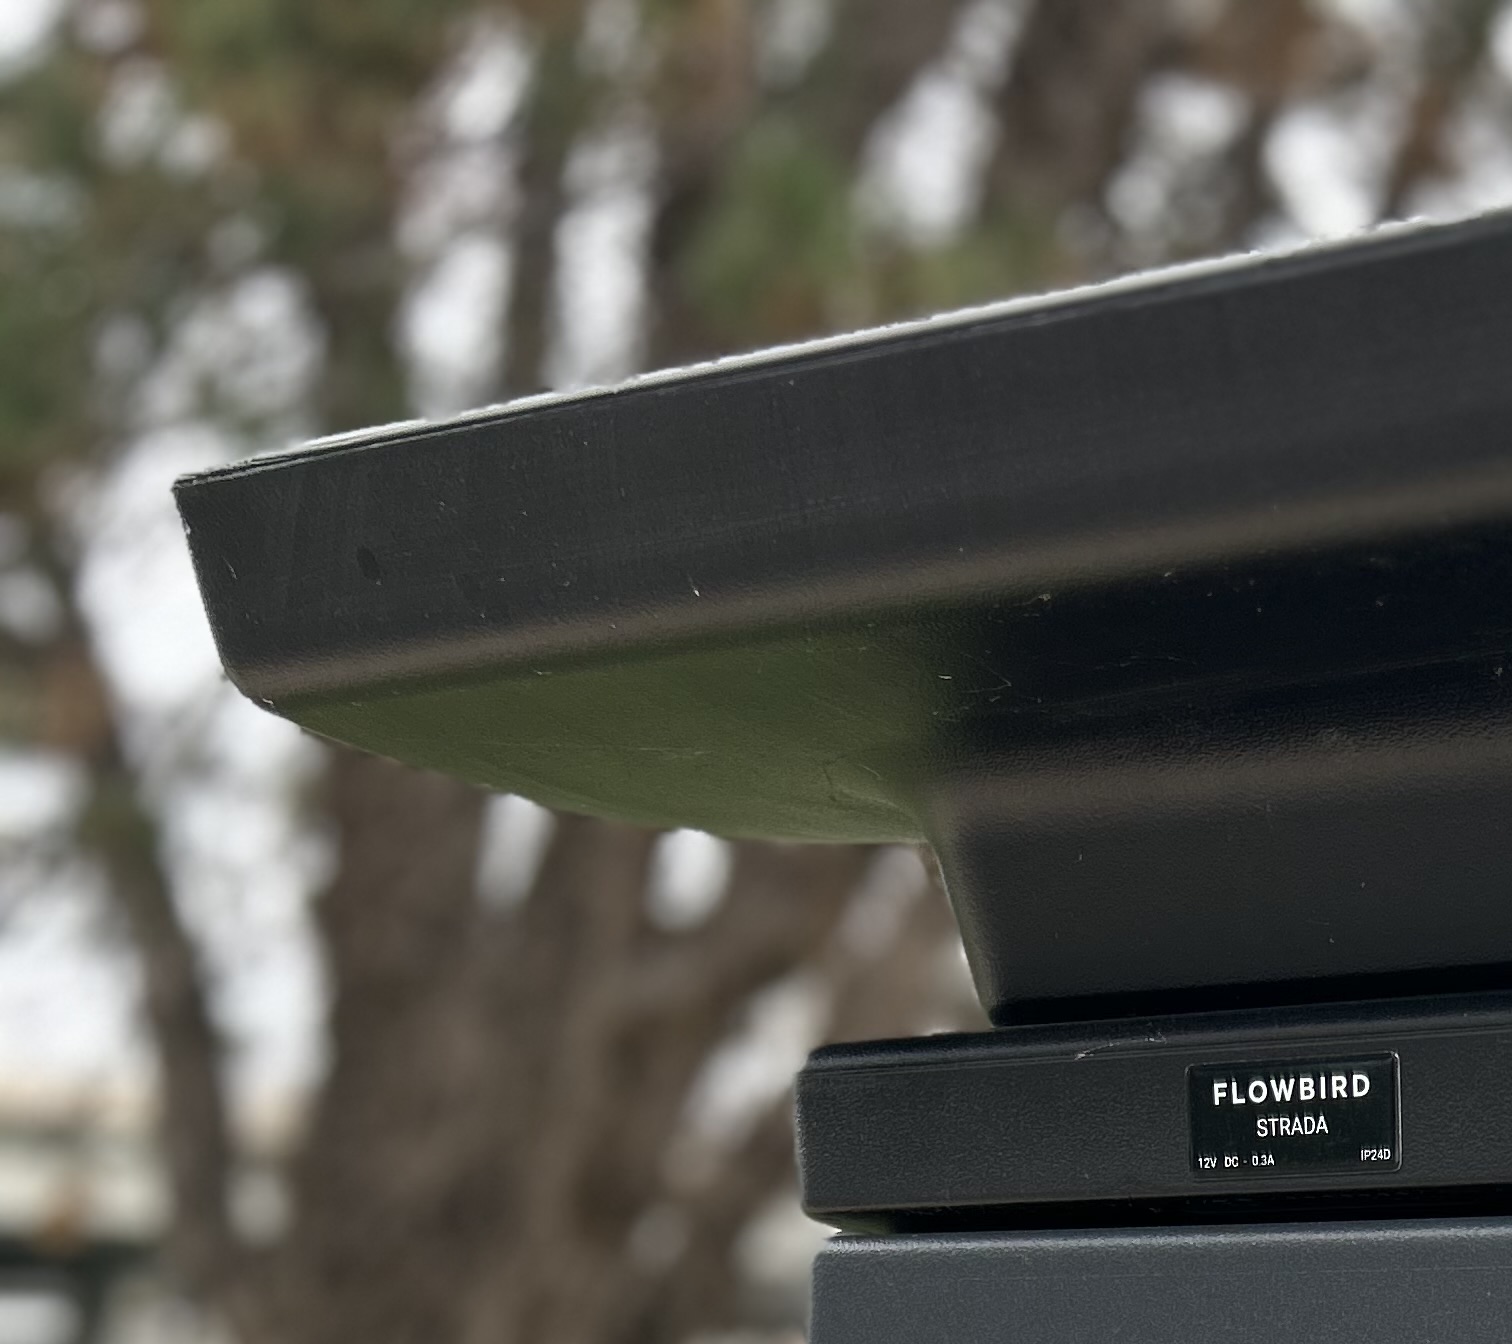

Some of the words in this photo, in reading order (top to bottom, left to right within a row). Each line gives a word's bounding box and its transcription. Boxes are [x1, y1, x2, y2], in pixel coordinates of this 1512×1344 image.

[1213, 1074, 1370, 1106] FLOWBIRD
[1256, 1115, 1329, 1138] STRADA
[1198, 1156, 1217, 1169] 12V
[1224, 1156, 1239, 1168] DC
[1360, 1149, 1391, 1161] IP24D
